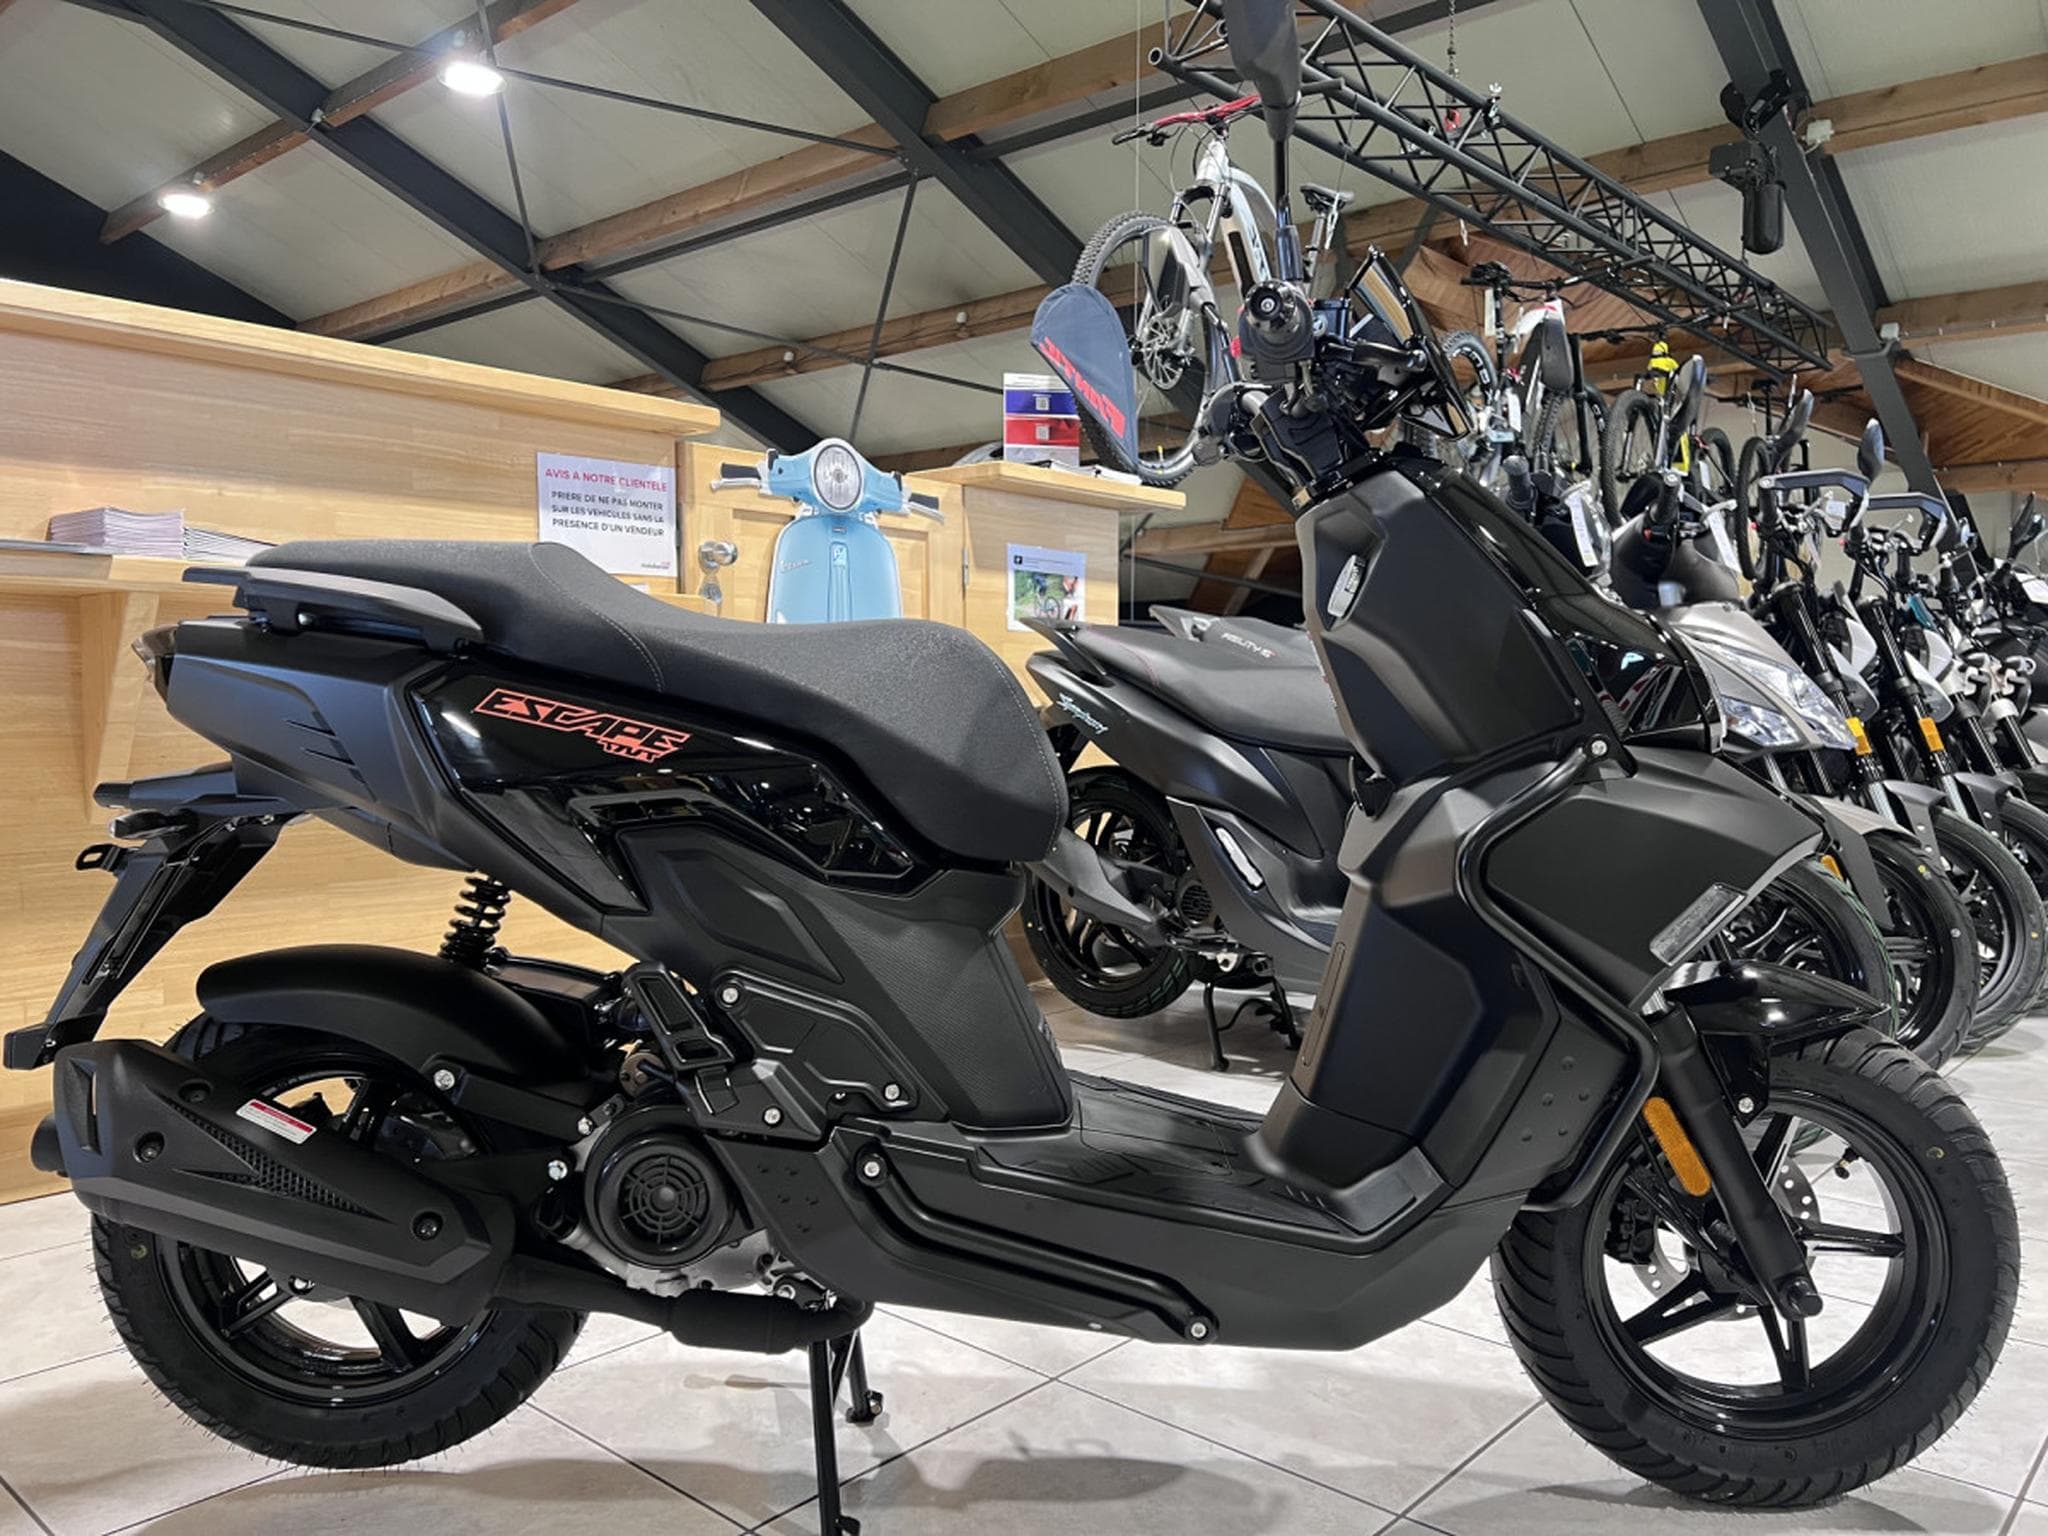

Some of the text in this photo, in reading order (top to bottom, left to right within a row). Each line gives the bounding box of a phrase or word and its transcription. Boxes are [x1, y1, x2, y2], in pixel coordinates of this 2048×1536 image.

[545, 468, 570, 480] AVIS
[572, 470, 581, 481] A
[583, 472, 616, 486] NOTRE
[584, 493, 597, 503] DE
[598, 495, 610, 505] NE
[611, 497, 628, 507] PAS
[629, 499, 664, 511] MONTER
[551, 504, 569, 513] SUR
[570, 506, 586, 516] LES
[632, 512, 653, 523] SANS
[654, 515, 665, 524] LA
[601, 522, 624, 533] D'UN
[624, 524, 665, 537] VENDEUR
[474, 688, 693, 752] ESCAPE
